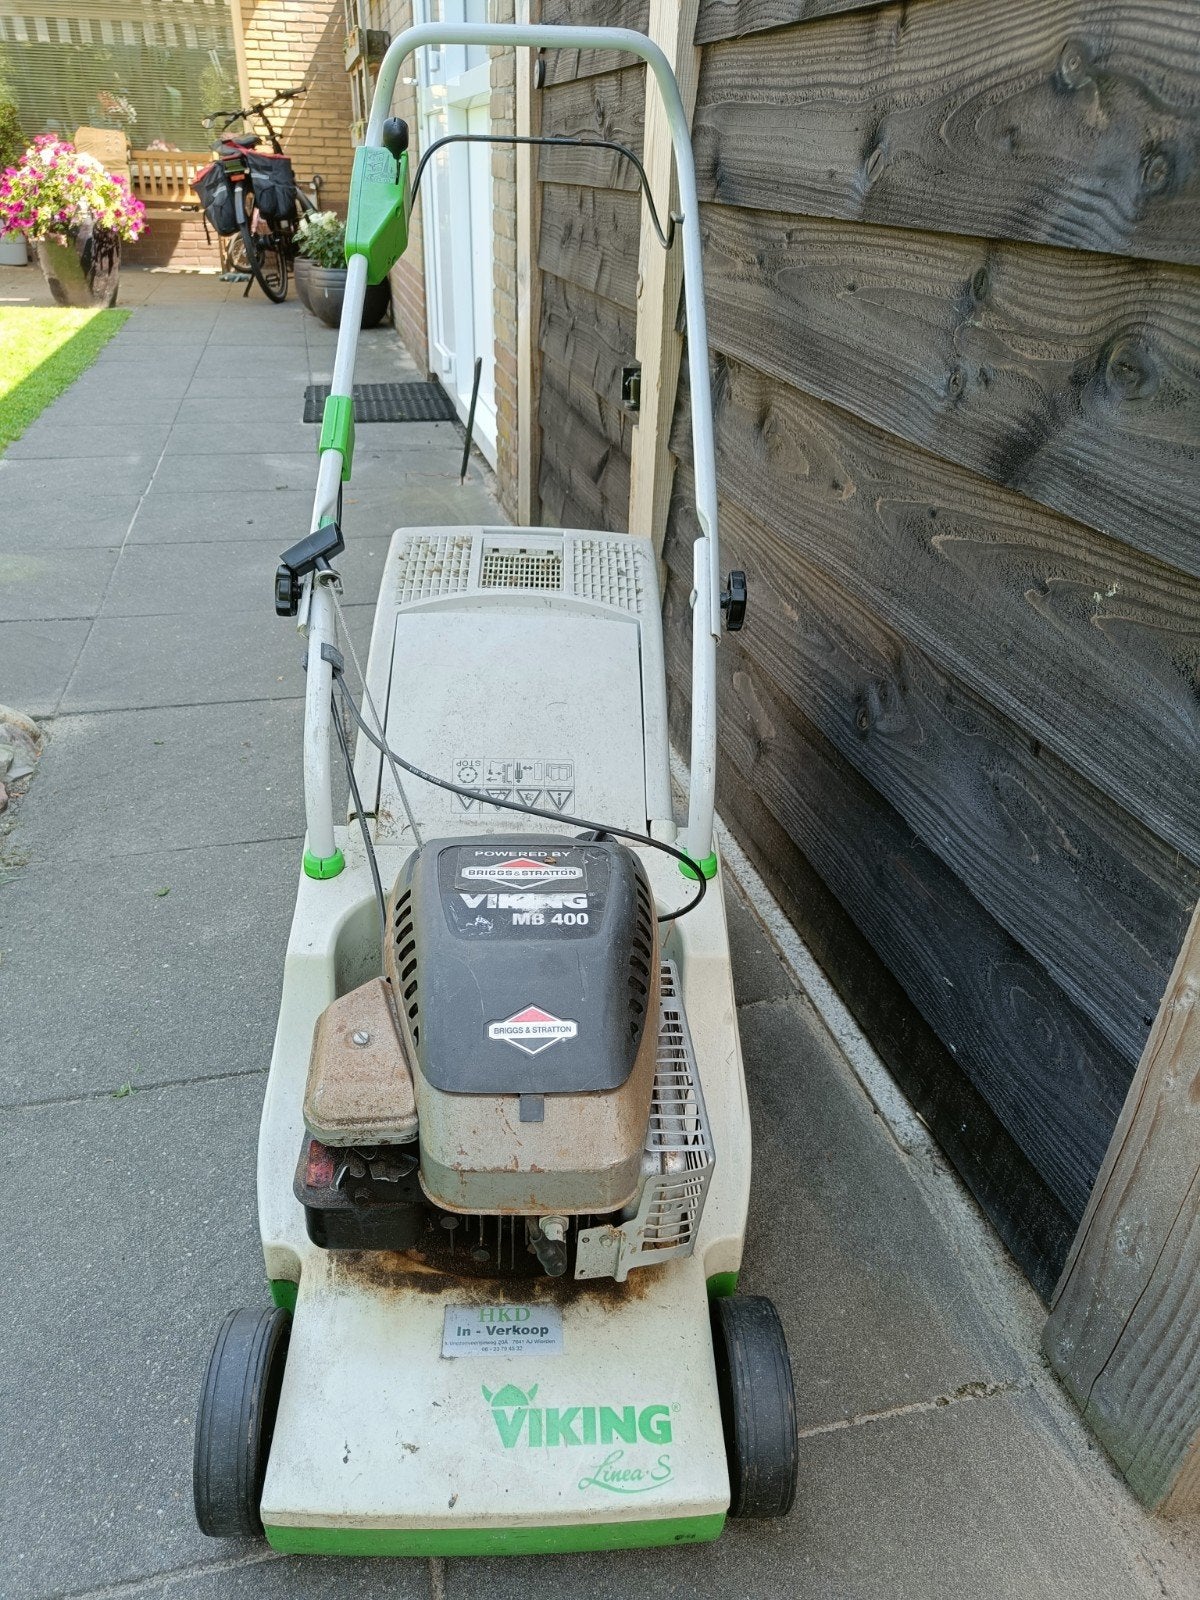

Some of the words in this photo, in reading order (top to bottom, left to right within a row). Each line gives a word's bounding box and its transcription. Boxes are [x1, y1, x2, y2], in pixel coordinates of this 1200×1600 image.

[456, 760, 481, 768] STOP
[512, 913, 545, 925] MB
[550, 913, 589, 925] 400
[493, 1027, 524, 1035] BRIGGS
[525, 1026, 531, 1034] &
[532, 1025, 572, 1033] STRATTON
[479, 1307, 531, 1323] HKD
[456, 1326, 471, 1336] In
[486, 1325, 549, 1337] Verkoop
[492, 1405, 672, 1448] VIKING
